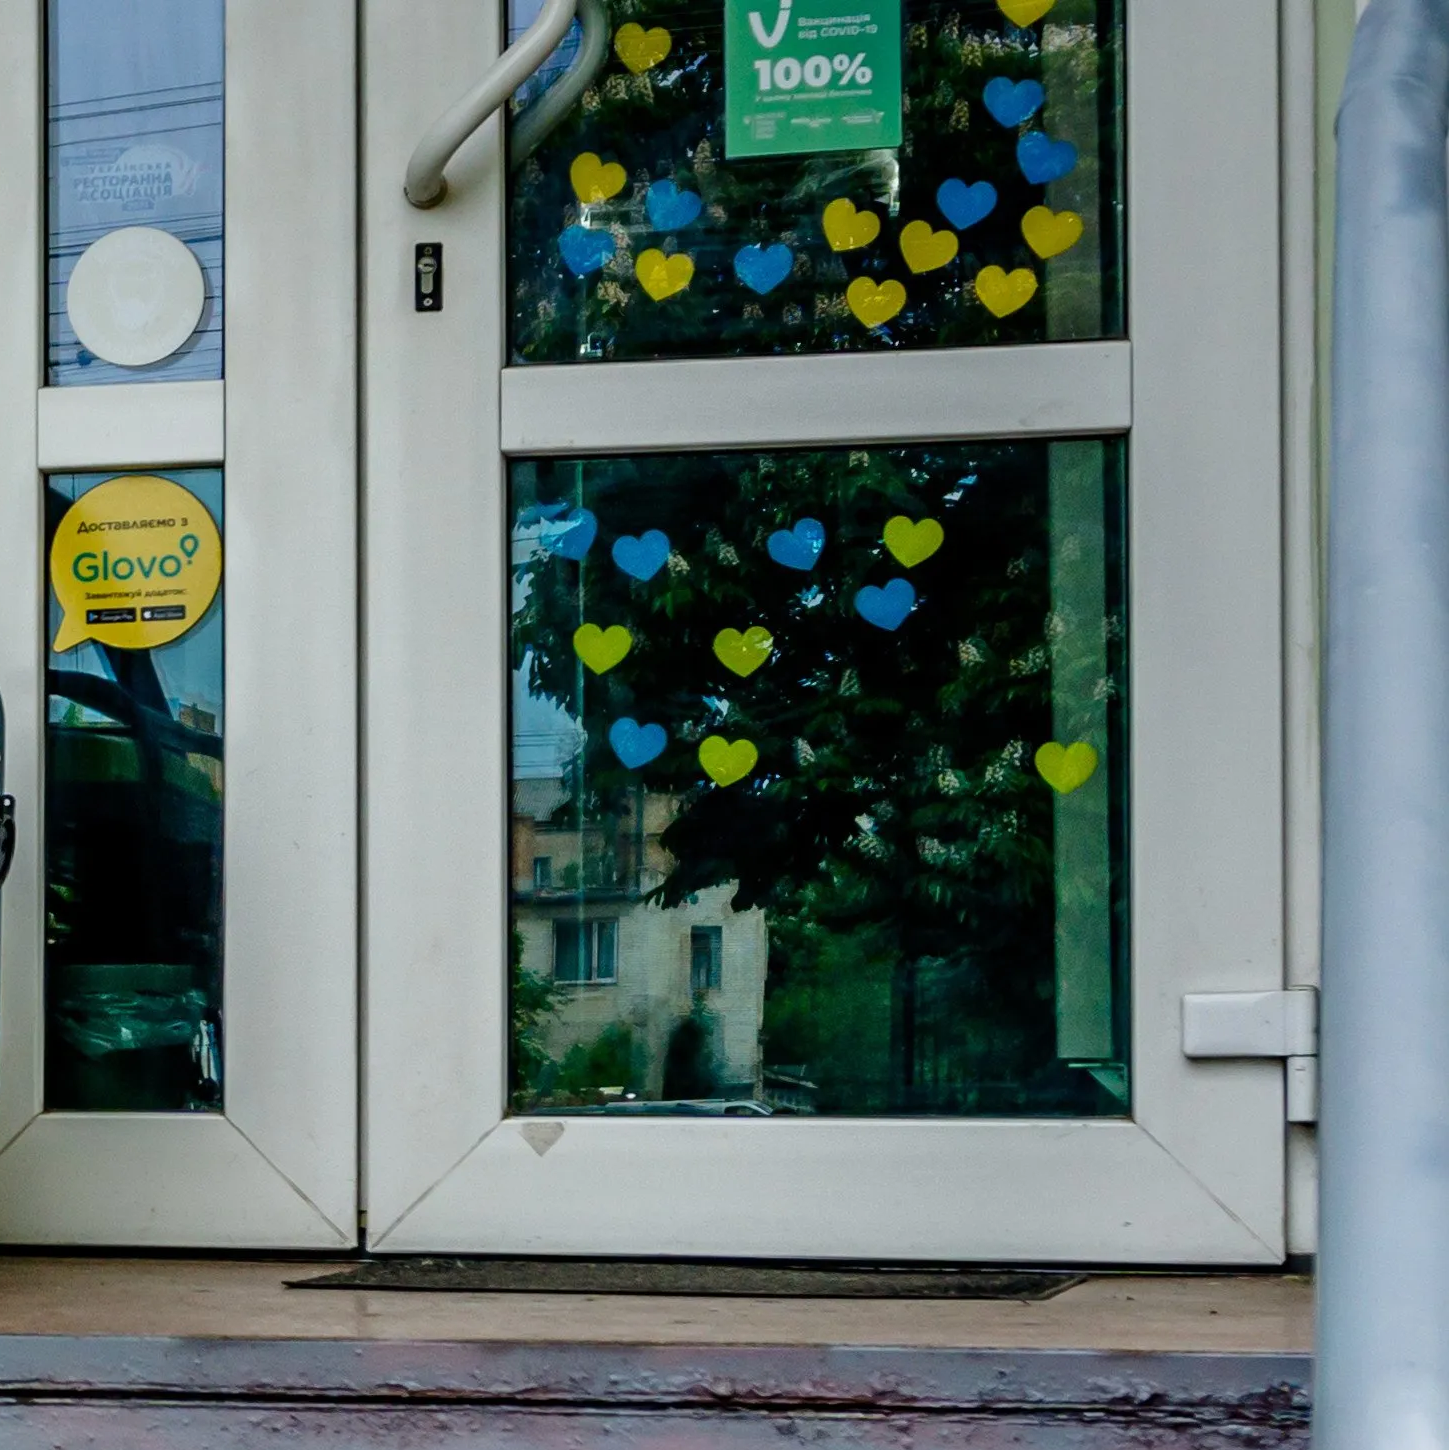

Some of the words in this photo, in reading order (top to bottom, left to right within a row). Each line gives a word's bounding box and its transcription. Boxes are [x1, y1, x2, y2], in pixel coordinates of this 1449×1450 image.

[820, 24, 878, 37] COVID-19
[753, 52, 874, 91] 100%
[73, 172, 174, 189] РЕСТОРАННА
[79, 185, 173, 202] АСОЦІАЦІЯ
[77, 518, 176, 534] Доставляємо
[72, 551, 182, 583] Glovo
